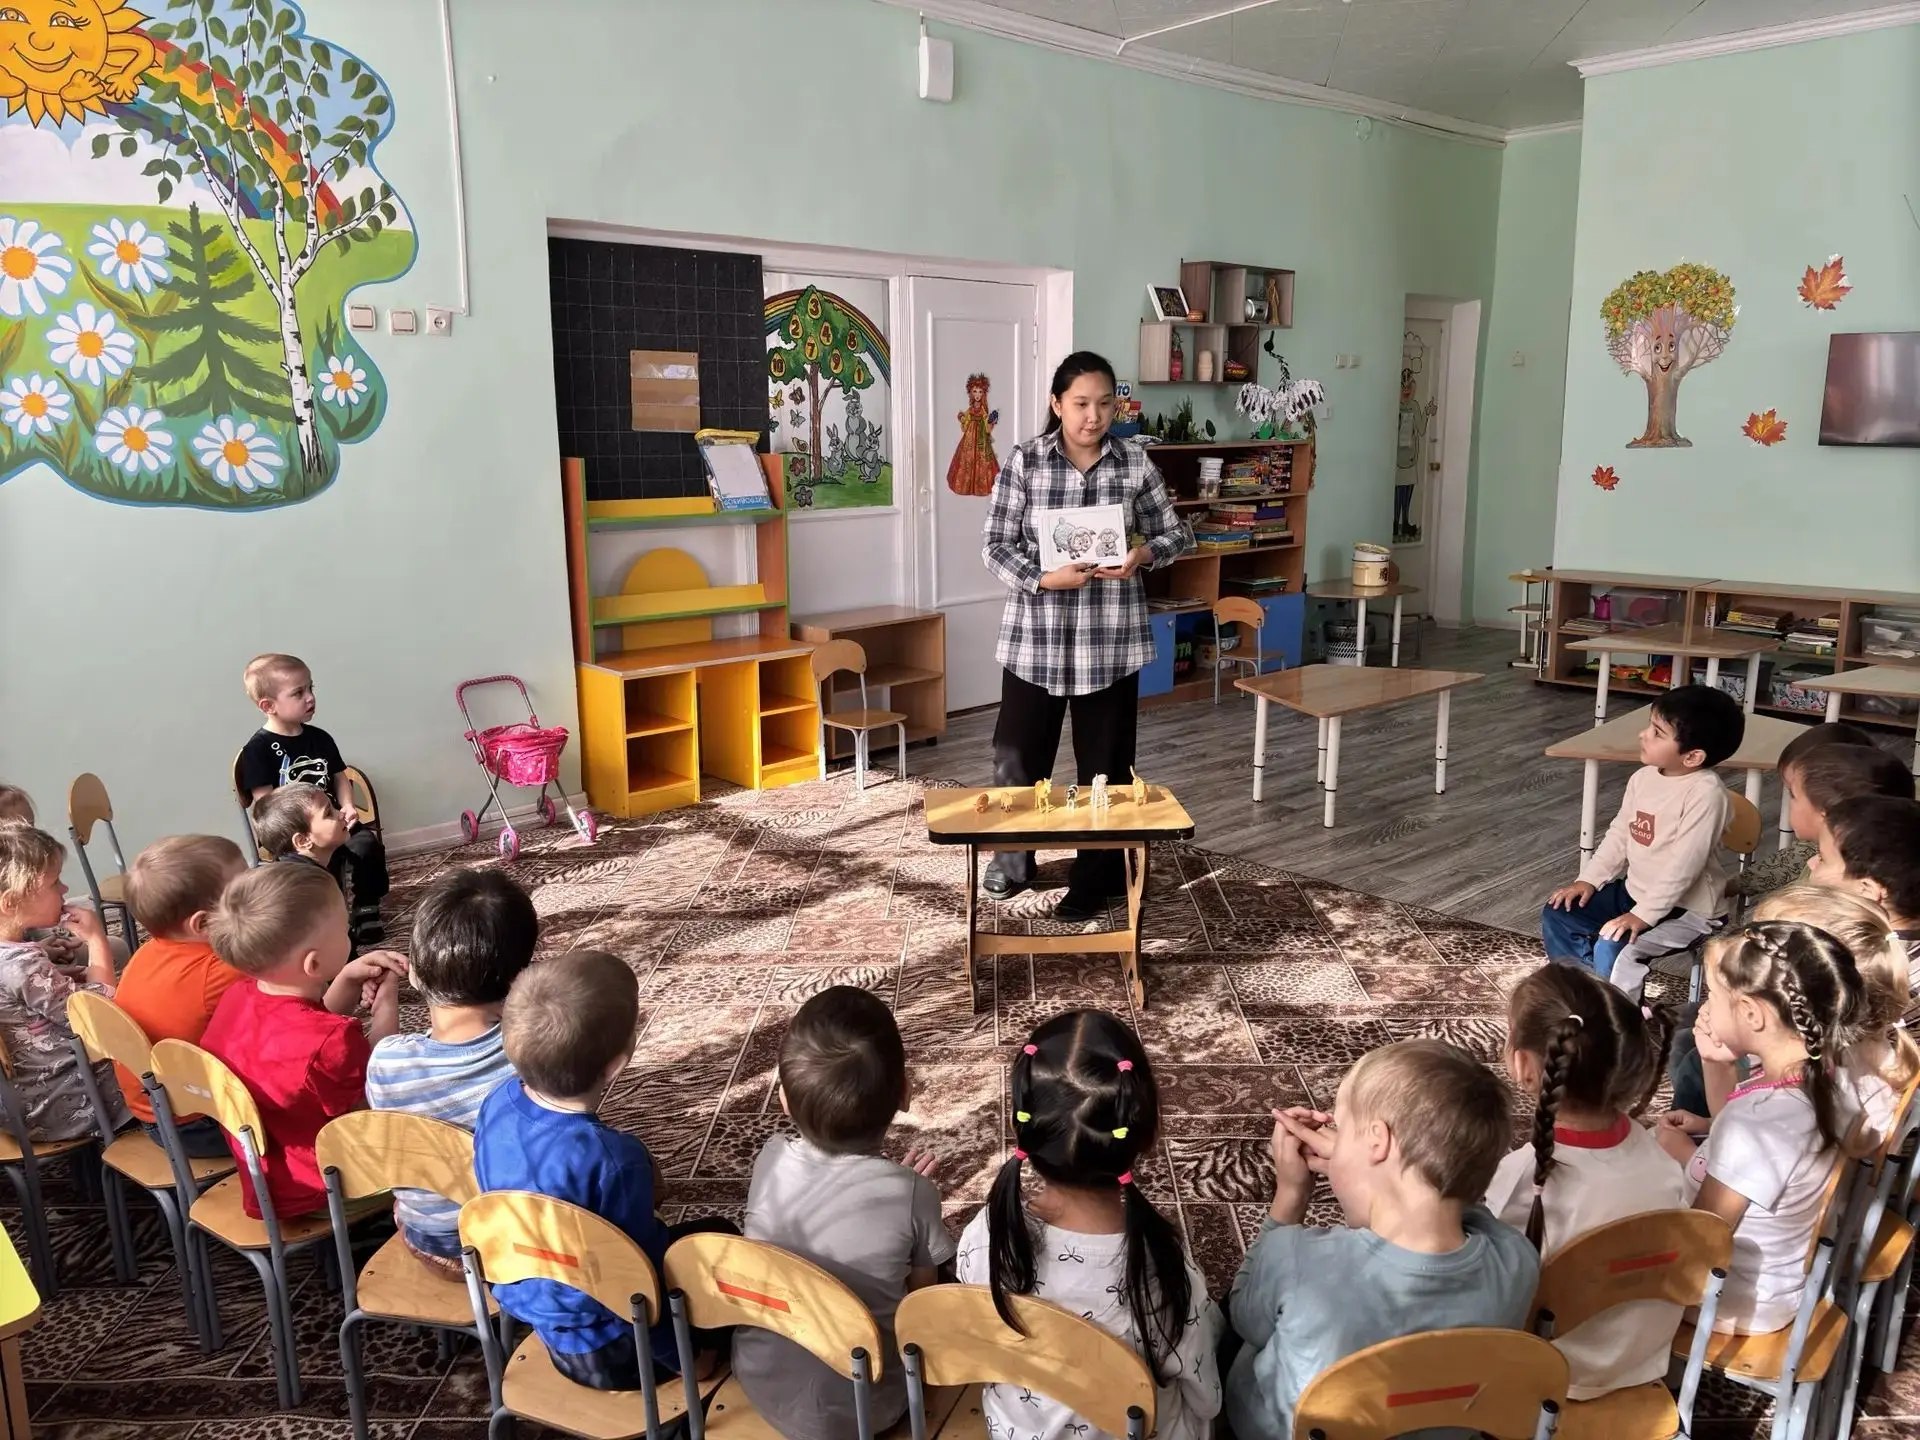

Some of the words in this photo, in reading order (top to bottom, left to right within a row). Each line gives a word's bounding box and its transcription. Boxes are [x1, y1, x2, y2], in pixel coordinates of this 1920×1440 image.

[809, 298, 819, 316] 3
[790, 319, 800, 336] 2
[821, 325, 831, 342] 4
[847, 331, 857, 350] 8
[807, 342, 815, 357] 7
[772, 358, 784, 373] 10
[831, 353, 840, 370] 9
